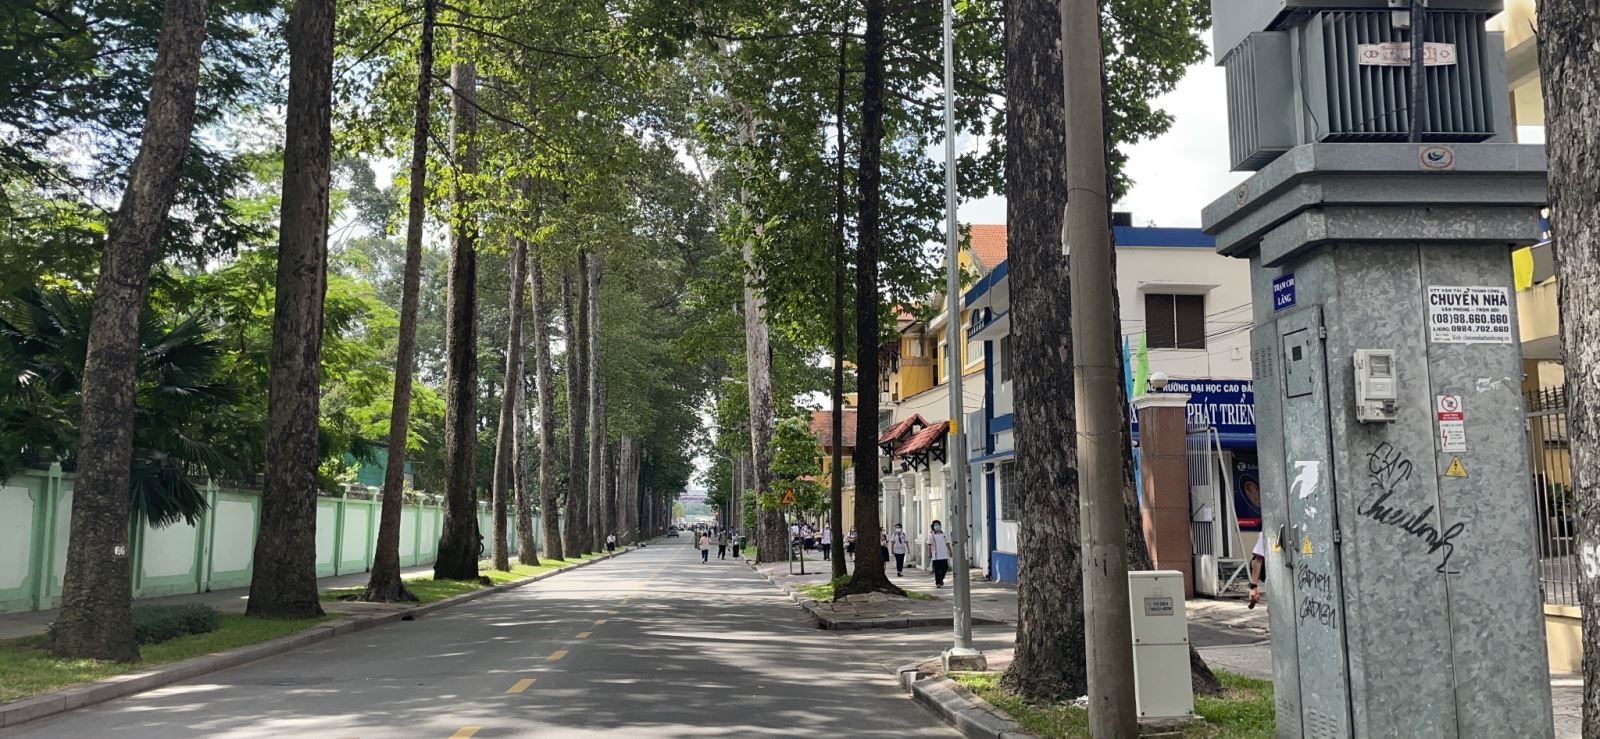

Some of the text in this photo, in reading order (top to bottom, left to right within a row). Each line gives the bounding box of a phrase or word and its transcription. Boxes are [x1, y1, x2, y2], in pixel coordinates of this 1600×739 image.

[1430, 288, 1508, 306] CHUYỂN NHÀ
[1432, 313, 1508, 324] (08)98.660.660
[1451, 325, 1509, 333] 0984.702.660
[1162, 382, 1189, 392] RƯỜNG
[1191, 384, 1204, 393] ĐẠI
[1205, 384, 1221, 394] HỌC
[1223, 384, 1239, 392] CAO
[1187, 397, 1217, 425] PHÁT
[1220, 394, 1255, 425] TRIỂN
